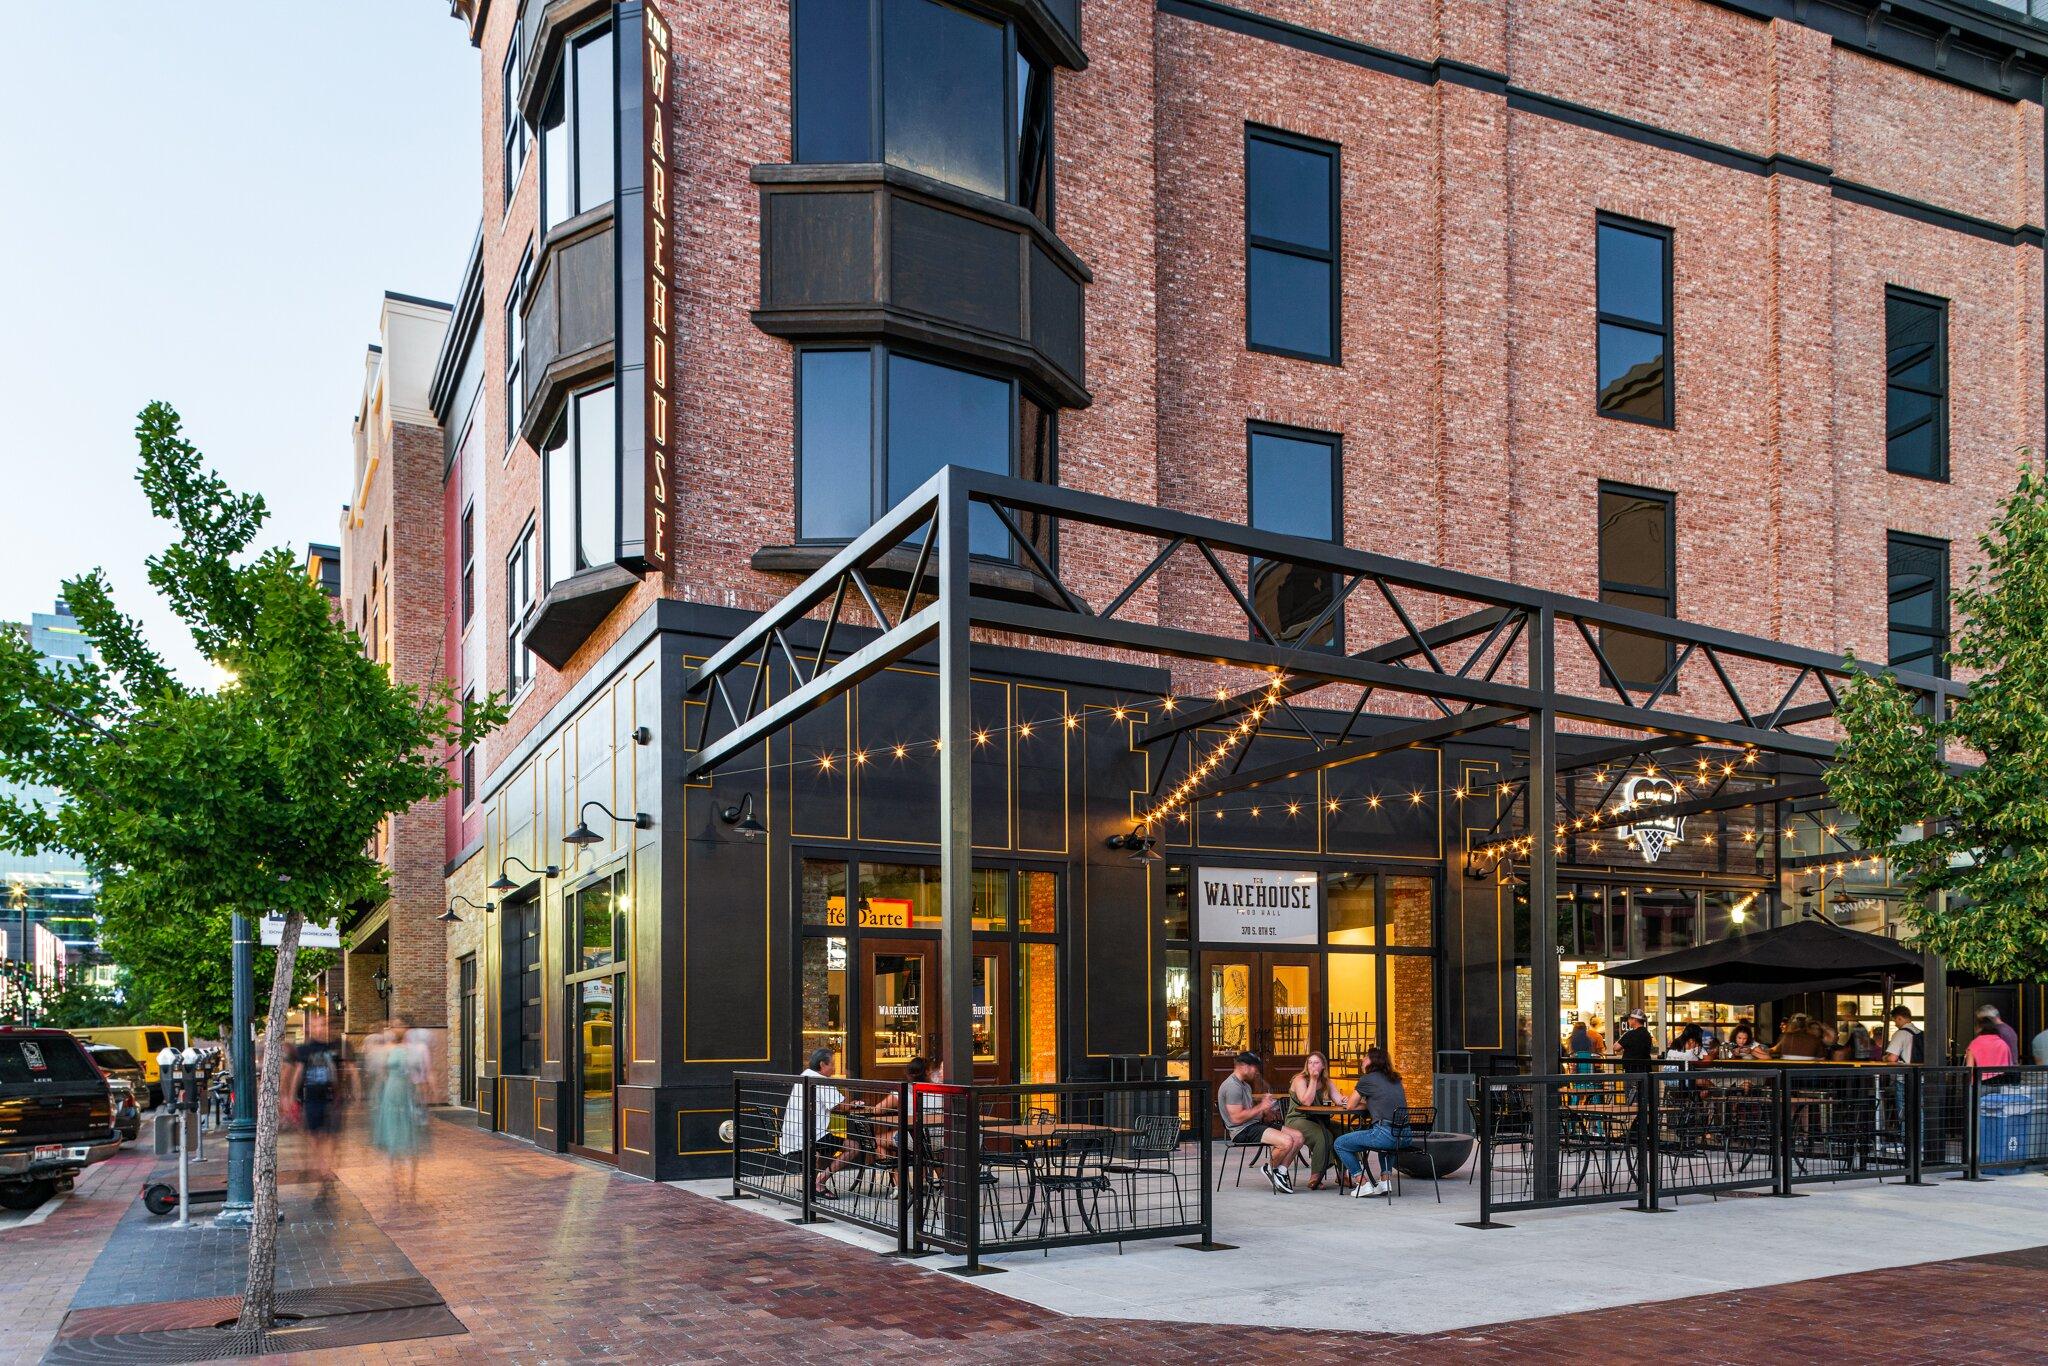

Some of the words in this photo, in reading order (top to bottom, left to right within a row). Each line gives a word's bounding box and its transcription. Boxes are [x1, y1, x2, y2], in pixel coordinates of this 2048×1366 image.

[646, 6, 668, 51] THE
[648, 38, 668, 562] WAREHOUSE
[1203, 881, 1311, 909] WAREHOUSE
[878, 1005, 920, 1015] WAREHOUSE
[972, 1005, 993, 1015] HOUSE
